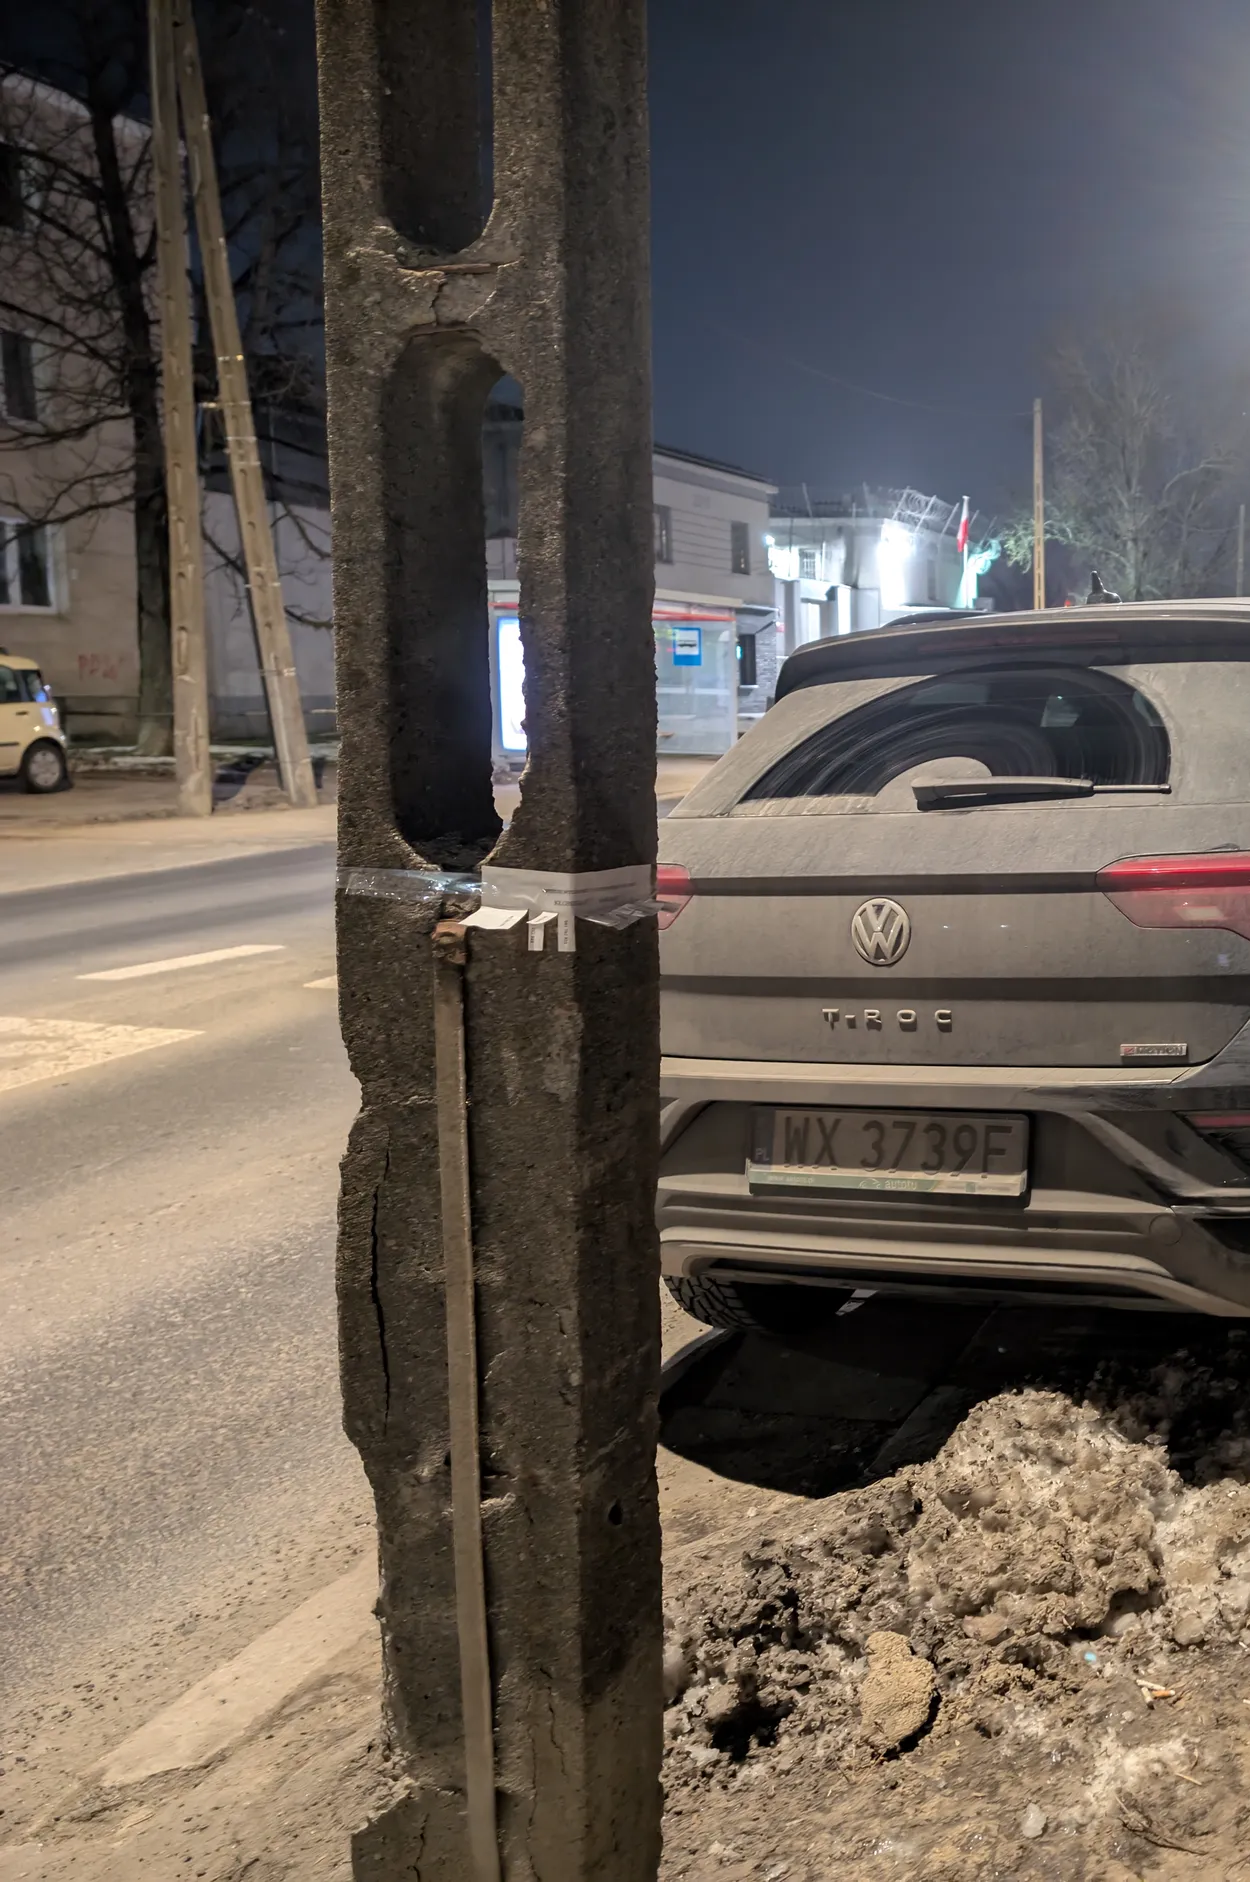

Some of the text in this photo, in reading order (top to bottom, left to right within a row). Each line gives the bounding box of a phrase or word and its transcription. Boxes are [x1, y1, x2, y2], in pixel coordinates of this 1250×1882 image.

[822, 1008, 952, 1023] T-ROC
[784, 1115, 1013, 1179] WX 3739F
[755, 1149, 770, 1162] PL
